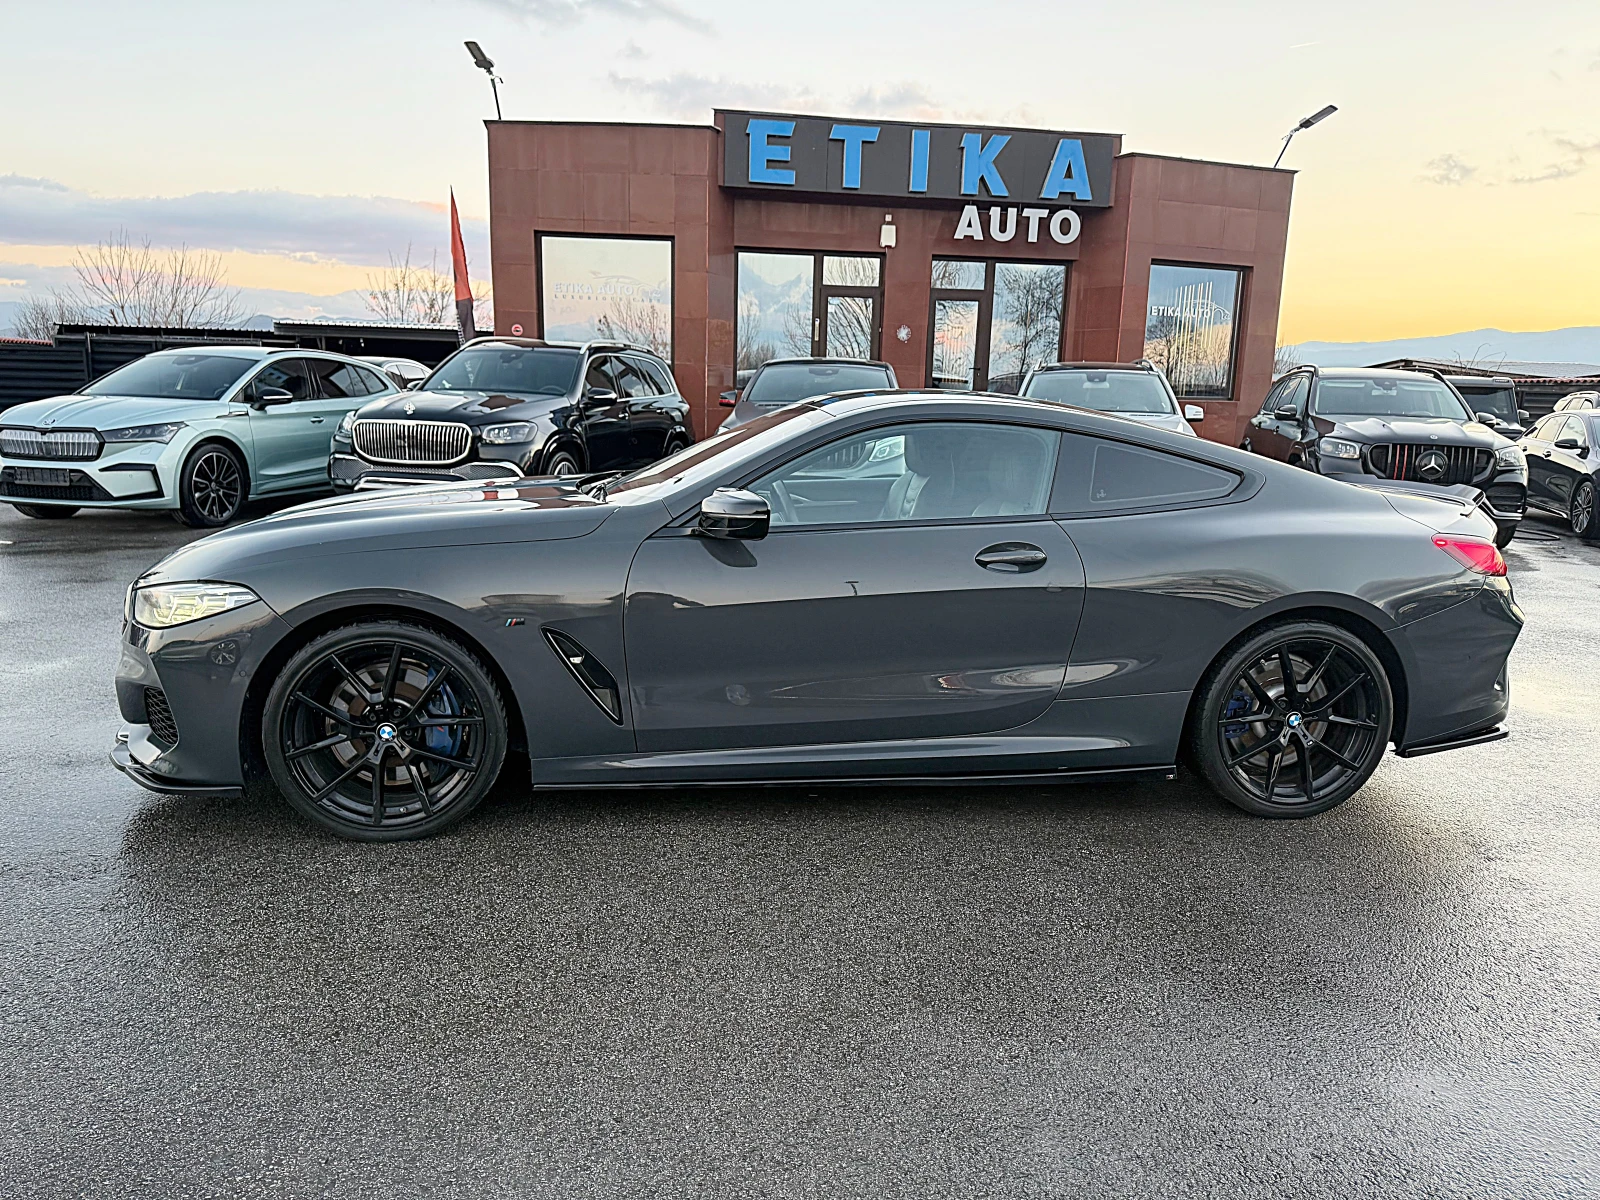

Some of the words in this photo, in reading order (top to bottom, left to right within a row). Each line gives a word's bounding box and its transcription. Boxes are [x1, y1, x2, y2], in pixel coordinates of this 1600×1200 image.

[746, 119, 1093, 201] ETIKA
[953, 205, 1082, 244] AUTO
[554, 282, 594, 295] ETIKA
[597, 283, 634, 296] AUTO
[1151, 305, 1181, 317] ETIKA
